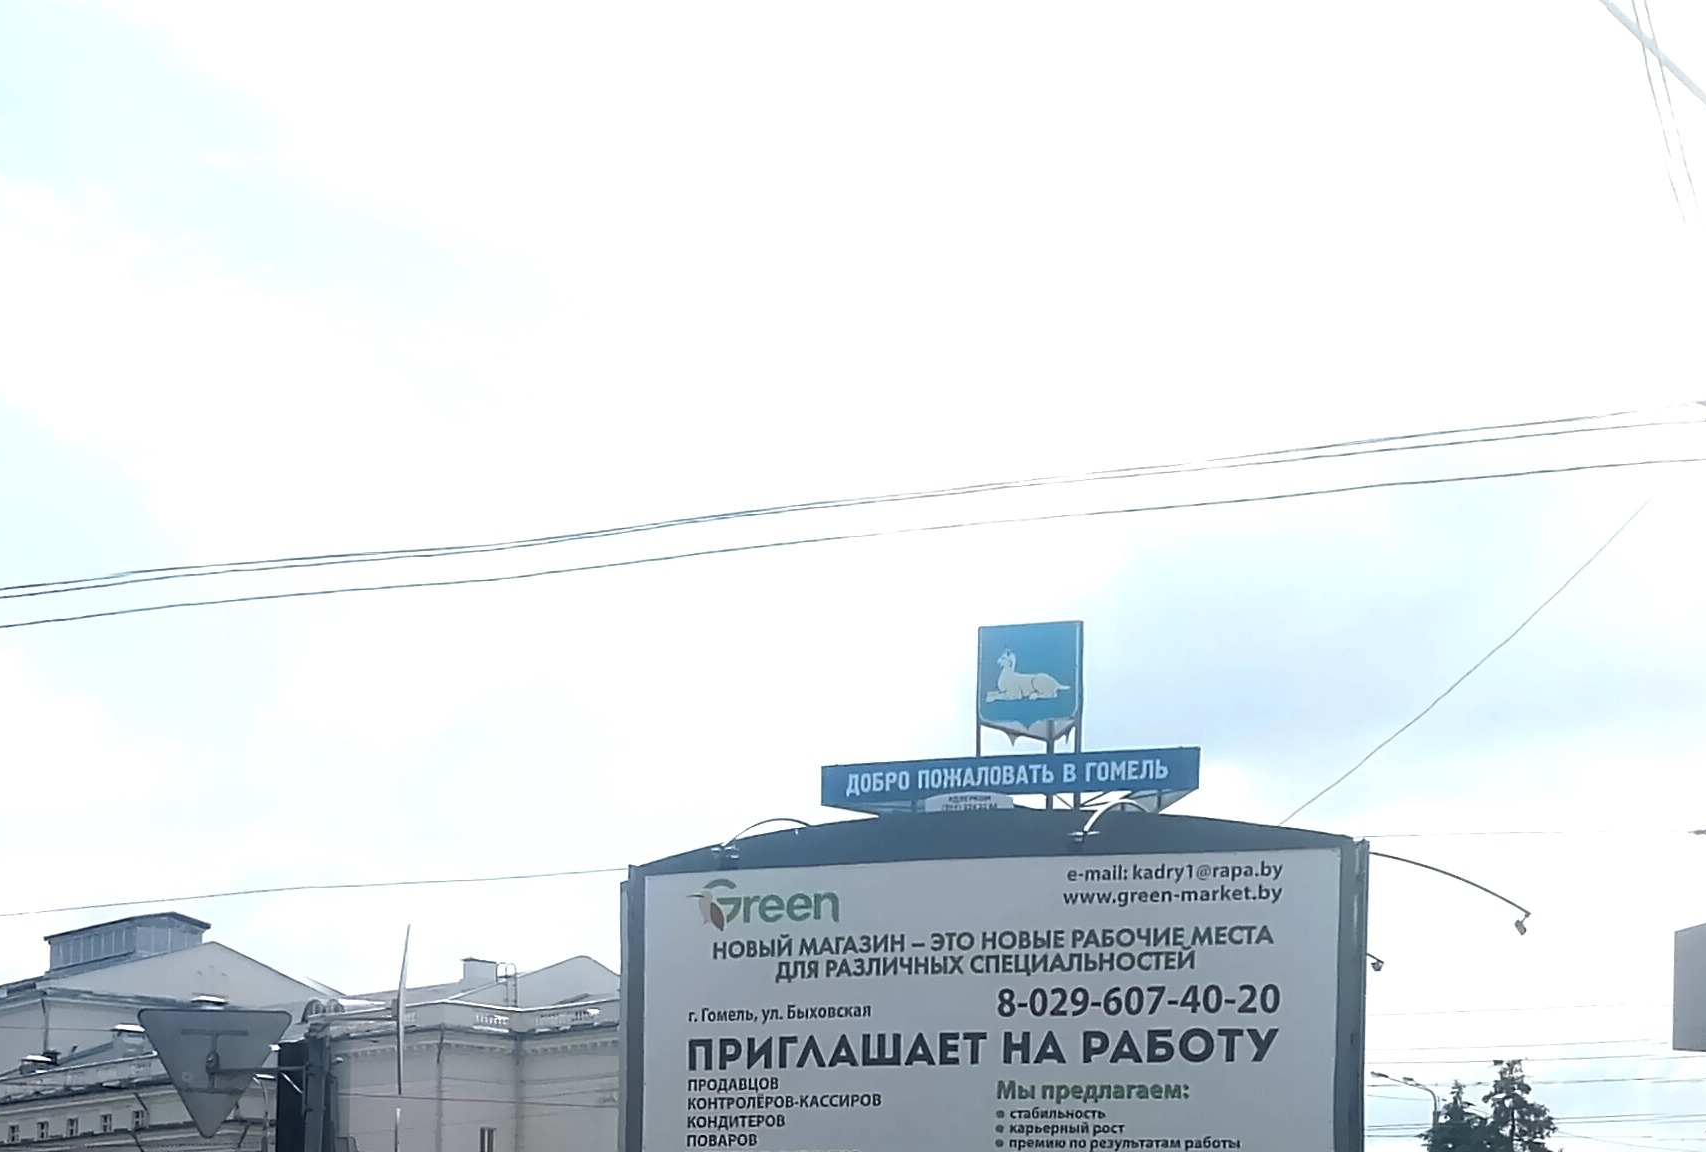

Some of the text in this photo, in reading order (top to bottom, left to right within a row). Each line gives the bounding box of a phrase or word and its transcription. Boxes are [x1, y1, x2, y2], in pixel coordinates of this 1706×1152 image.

[846, 759, 1168, 797] ДОБРО ПОЖАЛОВАТЬ В ГОМЕЛЬ
[1067, 861, 1283, 883] e-mail: kadry1@rapa.by
[696, 878, 840, 926] Green
[1062, 885, 1283, 907] www.green-market.by
[712, 934, 793, 960] НОВЫЙ
[798, 934, 905, 957] МАГАЗИН
[930, 931, 975, 951] ЭТО
[981, 929, 1065, 950] НОВЫЕ
[1071, 927, 1185, 949] РАБОЧИЕ
[1190, 925, 1274, 946] МЕСТА
[775, 945, 1196, 984] ДЛЯ РАЗЛИЧНЫХ СПЕЦИАЛЬНОСТЕЙ
[997, 983, 1282, 1018] 8-029-607-40-20
[688, 1004, 871, 1025] г. Гомель, ул. Быховская
[688, 1027, 1280, 1071] ПРИГЛАШАЕТ НА РАБОТУ
[687, 1077, 779, 1093] ПРОДАВЦОВ
[997, 1080, 1190, 1104] Мы предлагаем:
[687, 1093, 882, 1110] КОНТРОЛЁРОВ-КАССИРОВ
[687, 1115, 785, 1131] КОНДИТЕРОВ
[1009, 1107, 1106, 1120] стабильность
[1009, 1122, 1125, 1136] карьерный рост
[686, 1134, 757, 1148] ПОВАРОВ
[1008, 1137, 1067, 1149] премию
[1069, 1138, 1087, 1149] по
[1184, 1137, 1241, 1152] работы
